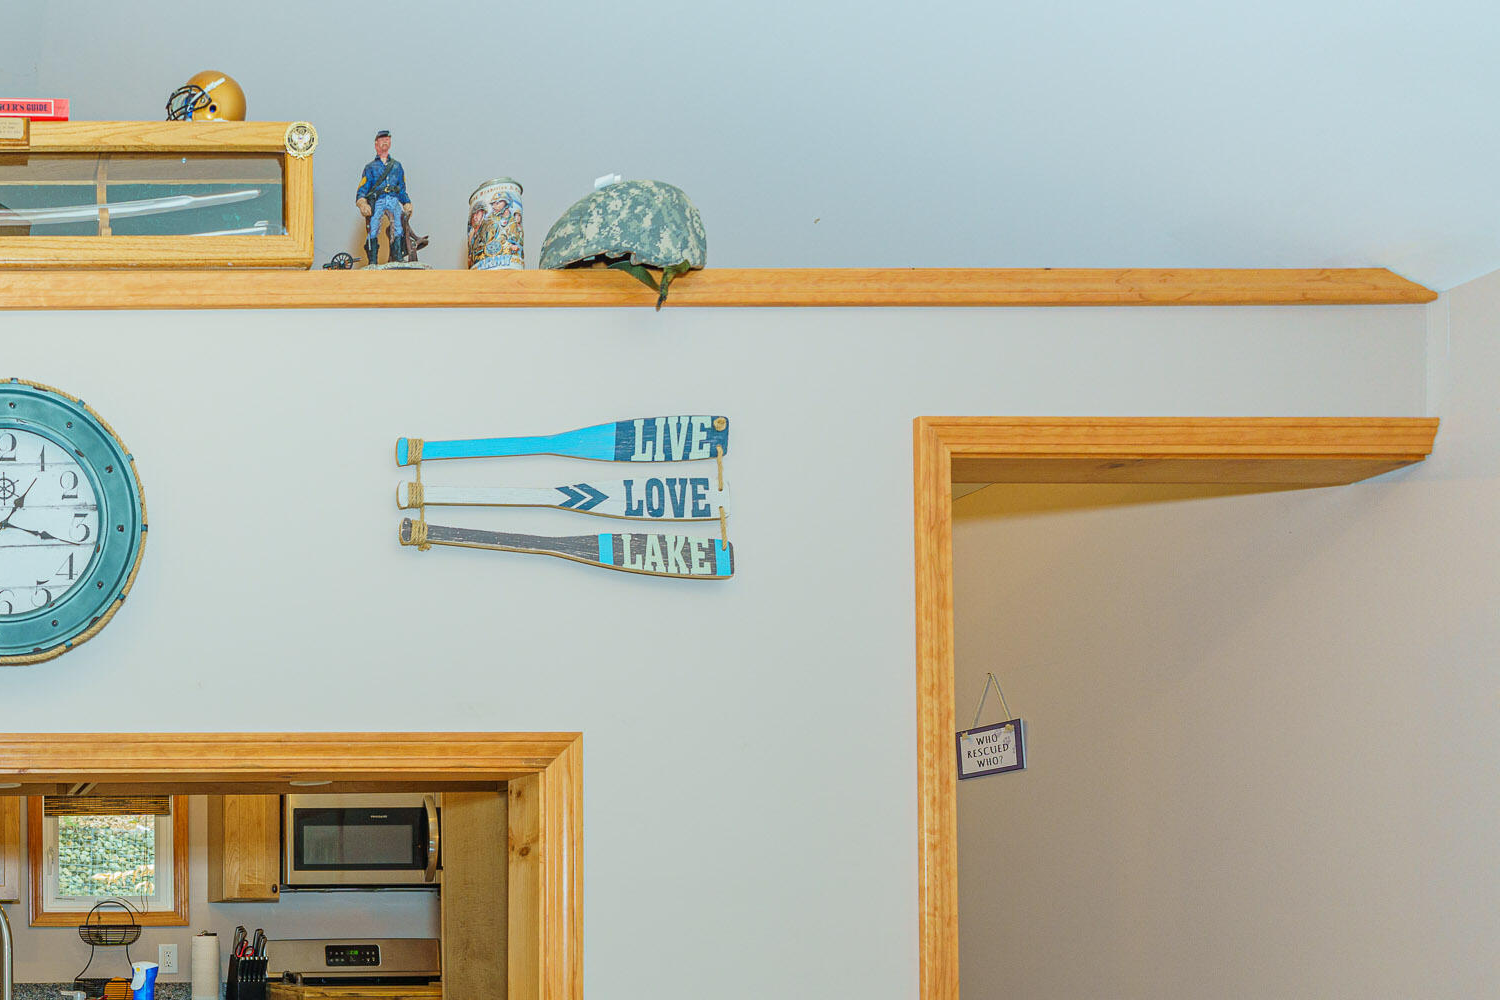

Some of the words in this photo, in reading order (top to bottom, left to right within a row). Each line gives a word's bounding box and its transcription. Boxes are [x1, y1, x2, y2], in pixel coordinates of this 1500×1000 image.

[26, 103, 47, 111] GUIDE
[631, 416, 712, 461] LIVE
[39, 444, 45, 472] 1
[59, 471, 78, 500] 2
[623, 478, 711, 518] LOVE
[69, 513, 90, 542] 3
[55, 552, 78, 580] 4
[621, 534, 712, 575] LAKE
[31, 580, 52, 608] 5
[967, 743, 1009, 758] RESCUED
[976, 733, 998, 745] WHO
[977, 755, 1003, 767] WHO?
